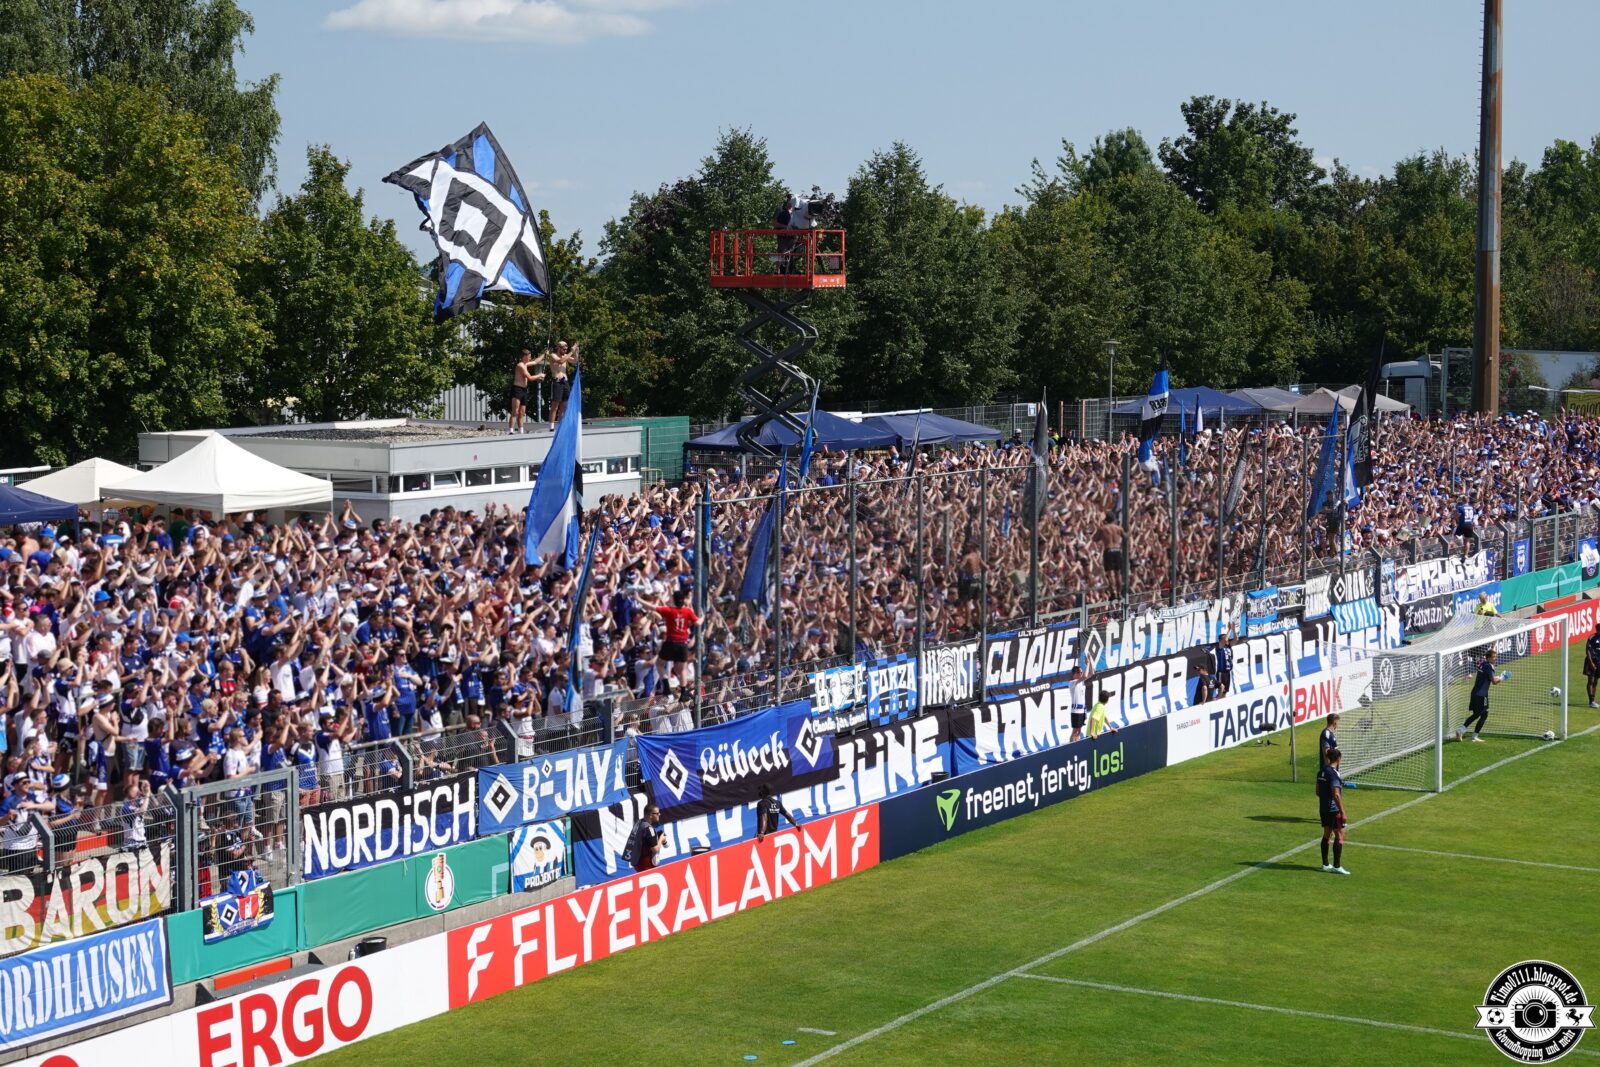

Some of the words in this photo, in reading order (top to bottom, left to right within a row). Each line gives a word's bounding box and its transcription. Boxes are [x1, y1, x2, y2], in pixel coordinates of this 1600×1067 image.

[1018, 627, 1047, 638] ULTRAS
[1105, 598, 1231, 669] CASTAWAYS
[1549, 607, 1593, 643] STAUSS
[868, 662, 917, 703] FORZA
[986, 628, 1079, 687] CLIQUE
[1030, 683, 1050, 693] NORD
[700, 731, 789, 786] Lübeck
[965, 772, 1039, 820] freenet,
[1041, 755, 1092, 796] fertig,
[1093, 741, 1124, 778] los!
[512, 818, 838, 988] FLYERALARM
[197, 965, 373, 1067] ERGO
